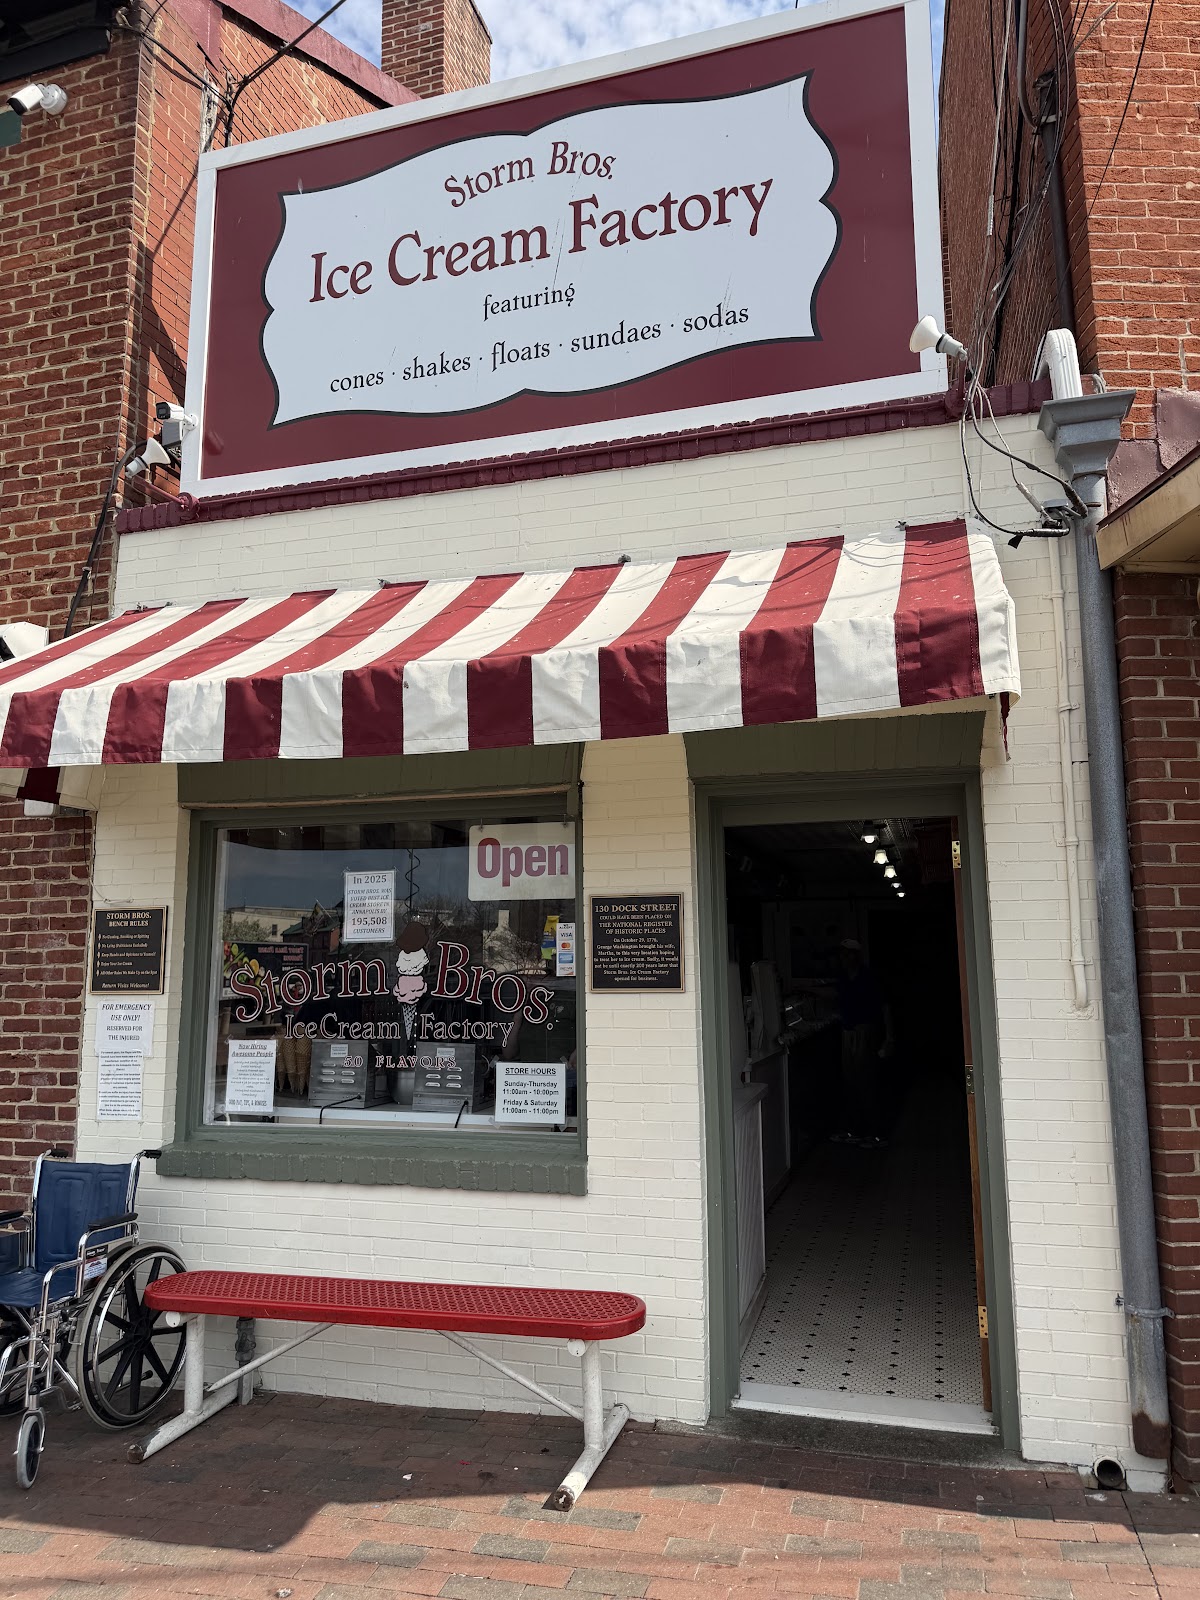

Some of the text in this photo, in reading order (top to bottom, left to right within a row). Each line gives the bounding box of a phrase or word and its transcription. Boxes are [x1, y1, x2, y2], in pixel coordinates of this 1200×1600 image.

[444, 141, 616, 207] Storm Bros.
[309, 178, 773, 303] Ice Cream Factory
[482, 282, 576, 321] featuring
[330, 303, 749, 392] cones shakes floats sundaes sodas
[478, 837, 568, 887] Open
[353, 875, 387, 884] In 2025
[611, 904, 638, 912] DOCK
[640, 903, 677, 911] STREET
[132, 911, 152, 919] BROS.
[352, 916, 388, 926] 195,508
[230, 941, 554, 1031] Storm Bros.
[101, 1003, 152, 1011] FOR EMERGENCY
[284, 1012, 515, 1047] Ice Cream Factory
[343, 1055, 457, 1068] 50 FLAVORS
[505, 1067, 529, 1075] STORE
[504, 1080, 558, 1089] Sunday-Thursday
[503, 1099, 523, 1107] Friday
[530, 1099, 558, 1108] Saturday
[533, 1108, 559, 1116] 11:00pm
